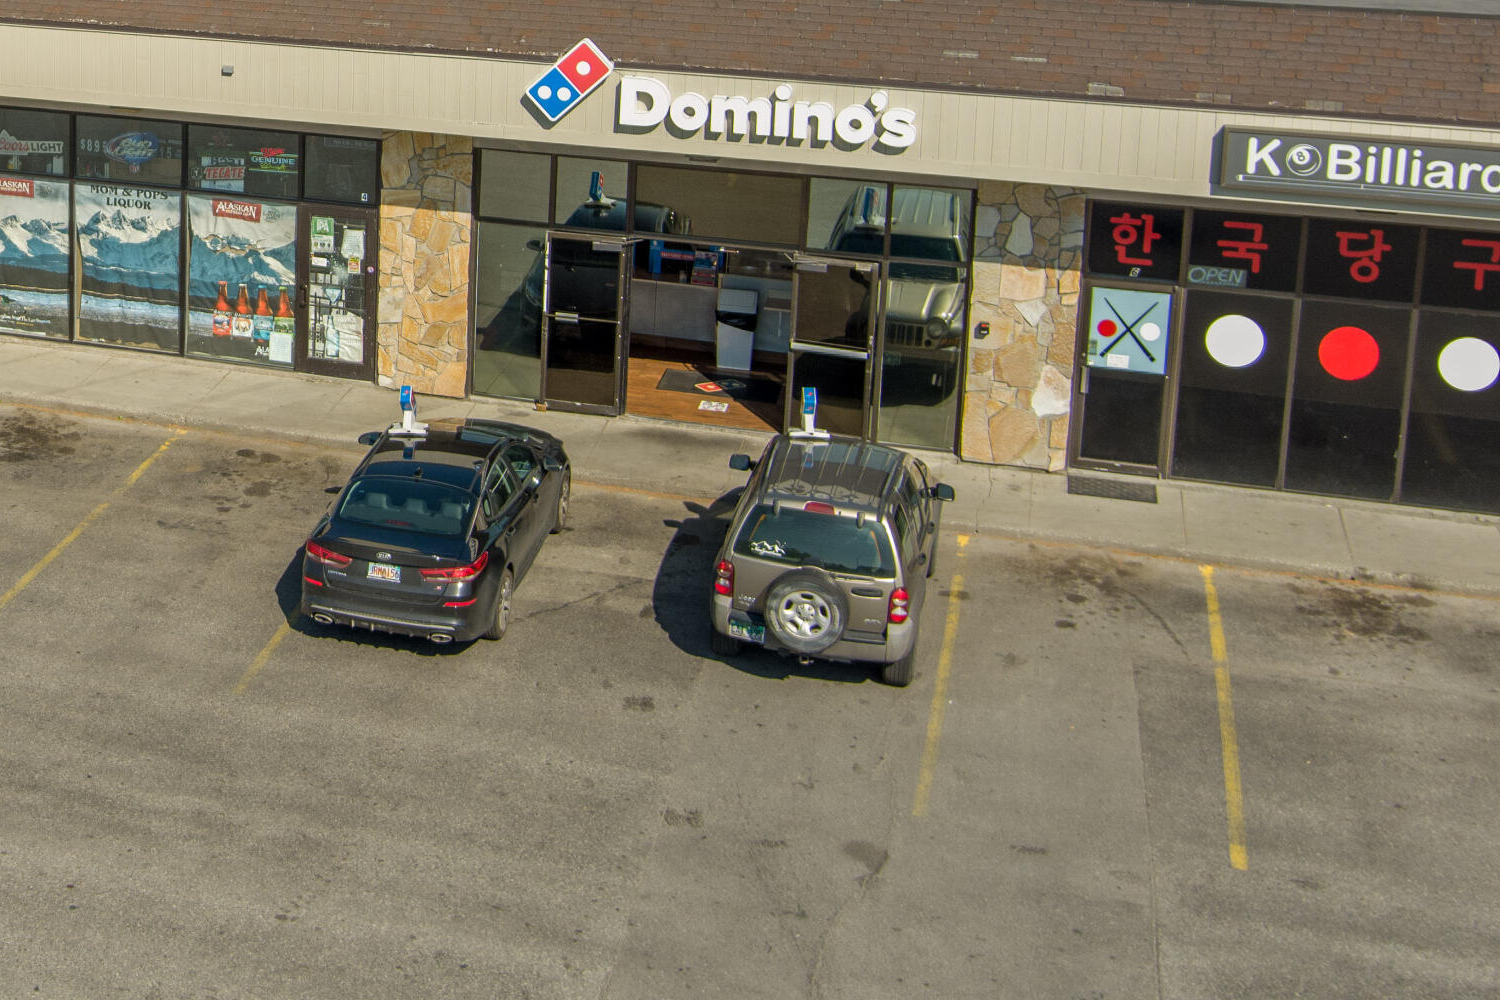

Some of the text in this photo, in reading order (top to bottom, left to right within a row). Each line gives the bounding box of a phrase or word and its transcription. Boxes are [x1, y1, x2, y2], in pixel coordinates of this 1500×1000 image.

[619, 76, 917, 148] Domino's
[30, 142, 62, 152] LIGHT
[251, 155, 296, 166] GENUINE
[1246, 137, 1282, 177] K
[205, 166, 244, 179] TECATE
[90, 184, 168, 200] MOM & POPS
[106, 196, 151, 210] LIQUOR
[215, 201, 257, 219] ALASKAN
[1129, 267, 1141, 277] 6
[1188, 266, 1245, 285] OPEN
